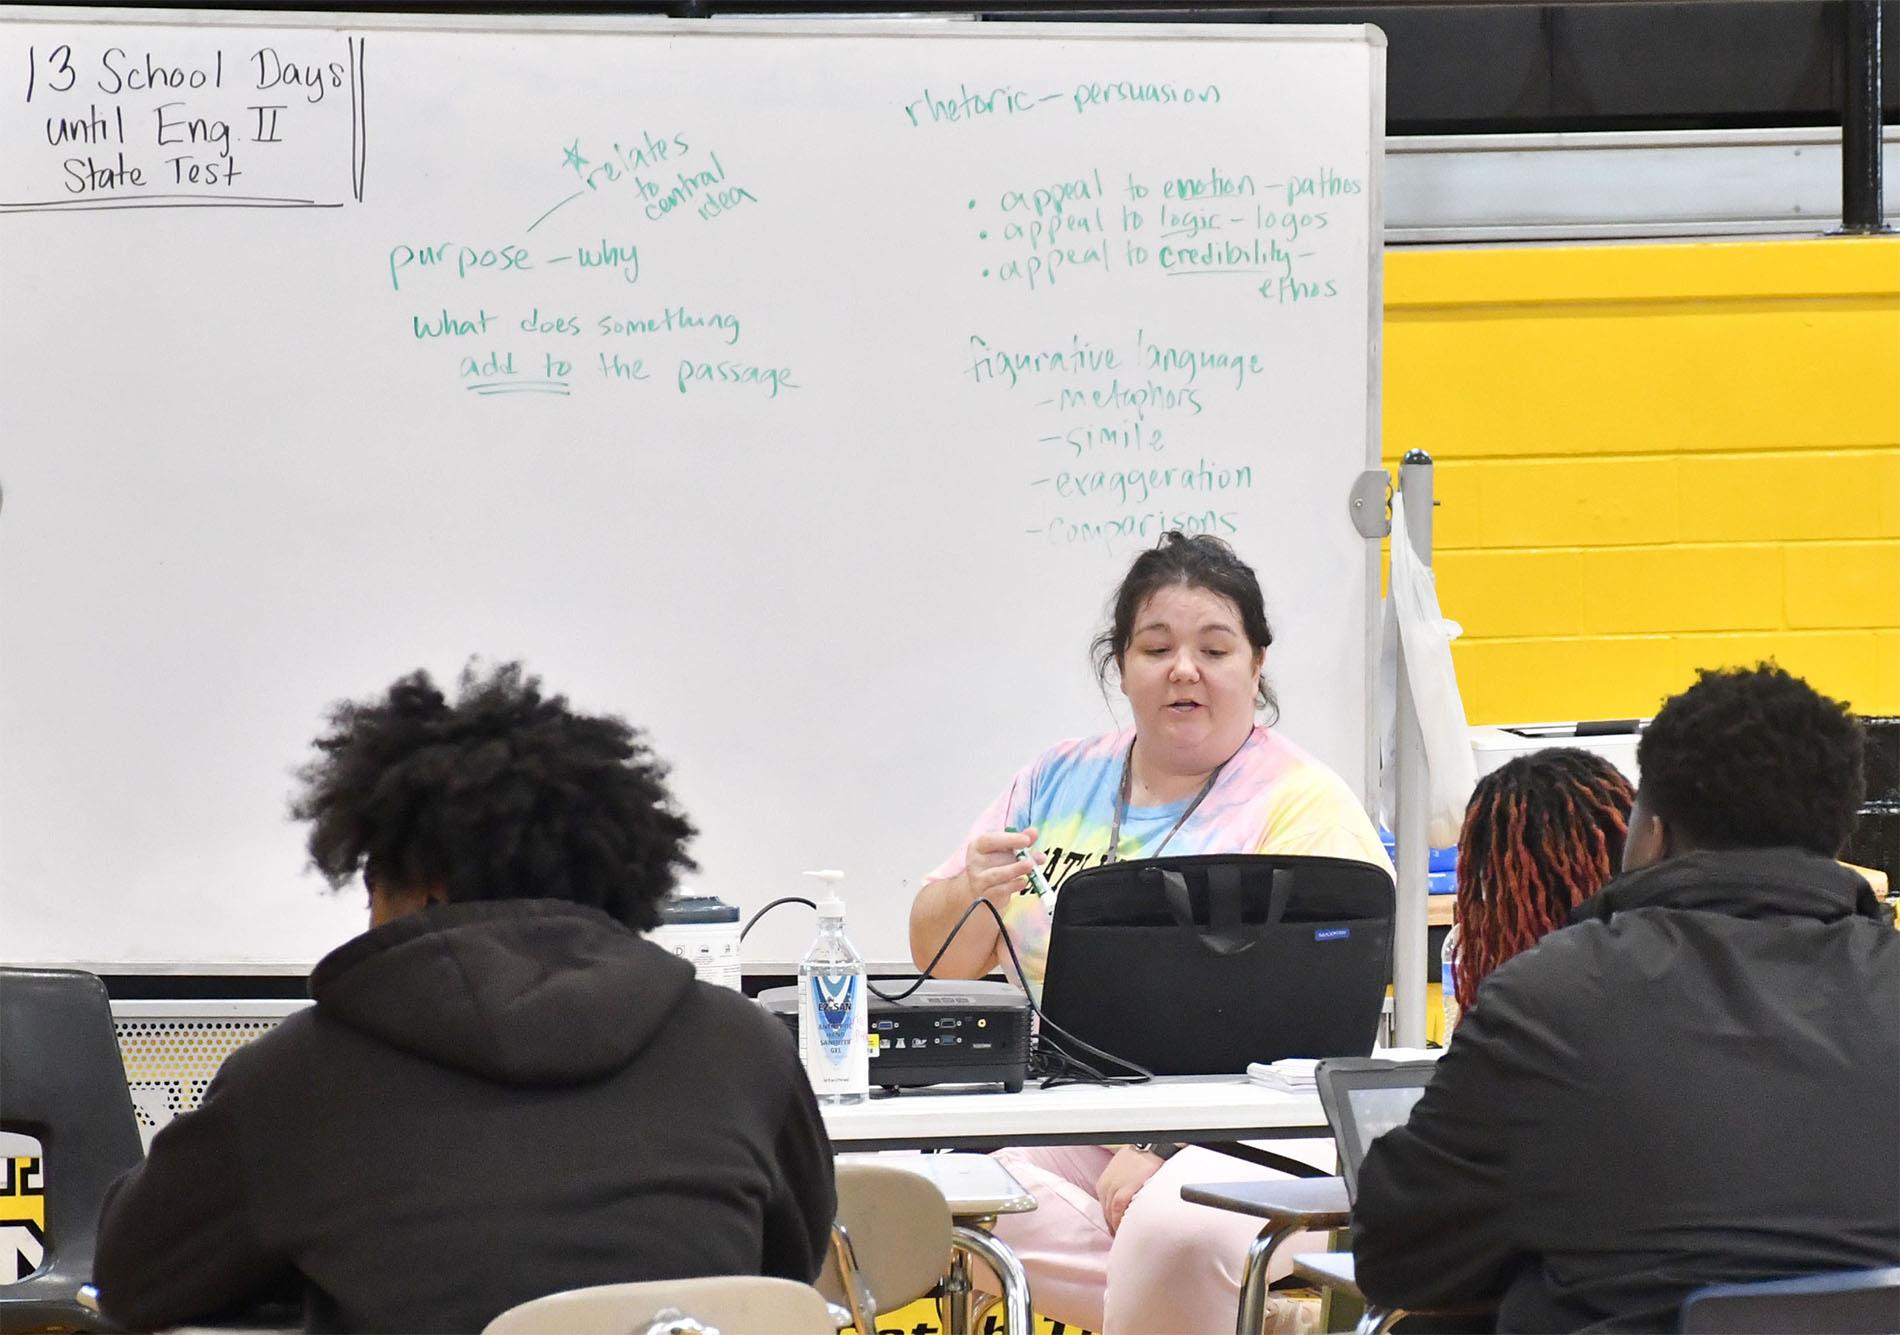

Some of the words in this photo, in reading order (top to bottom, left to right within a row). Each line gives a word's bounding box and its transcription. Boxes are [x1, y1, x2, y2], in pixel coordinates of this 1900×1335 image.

[26, 45, 76, 102] 13
[98, 47, 222, 94] School
[250, 47, 345, 103] Days
[1074, 80, 1221, 113] persuasion
[47, 104, 124, 146] until
[247, 105, 288, 142] II
[63, 152, 147, 193] State
[164, 156, 242, 187] Test
[586, 131, 690, 190] relates
[635, 176, 660, 200] to
[645, 151, 726, 222] central
[698, 185, 758, 221] idea
[1000, 168, 1103, 216] appeal
[1123, 173, 1150, 200] to
[1003, 207, 1104, 250] appeal
[1122, 205, 1144, 232] to
[1160, 204, 1222, 238] logic
[1256, 207, 1329, 242] logos
[389, 241, 533, 291] purpose
[999, 240, 1109, 291] appeal
[1127, 240, 1149, 267] to
[1258, 278, 1338, 304] ethos
[520, 309, 581, 338] does
[598, 308, 741, 346] something
[459, 352, 524, 379] add
[545, 353, 572, 379] to
[600, 353, 650, 381] the
[677, 359, 801, 400] passage
[964, 334, 1120, 389] figurative
[1136, 329, 1264, 391] language
